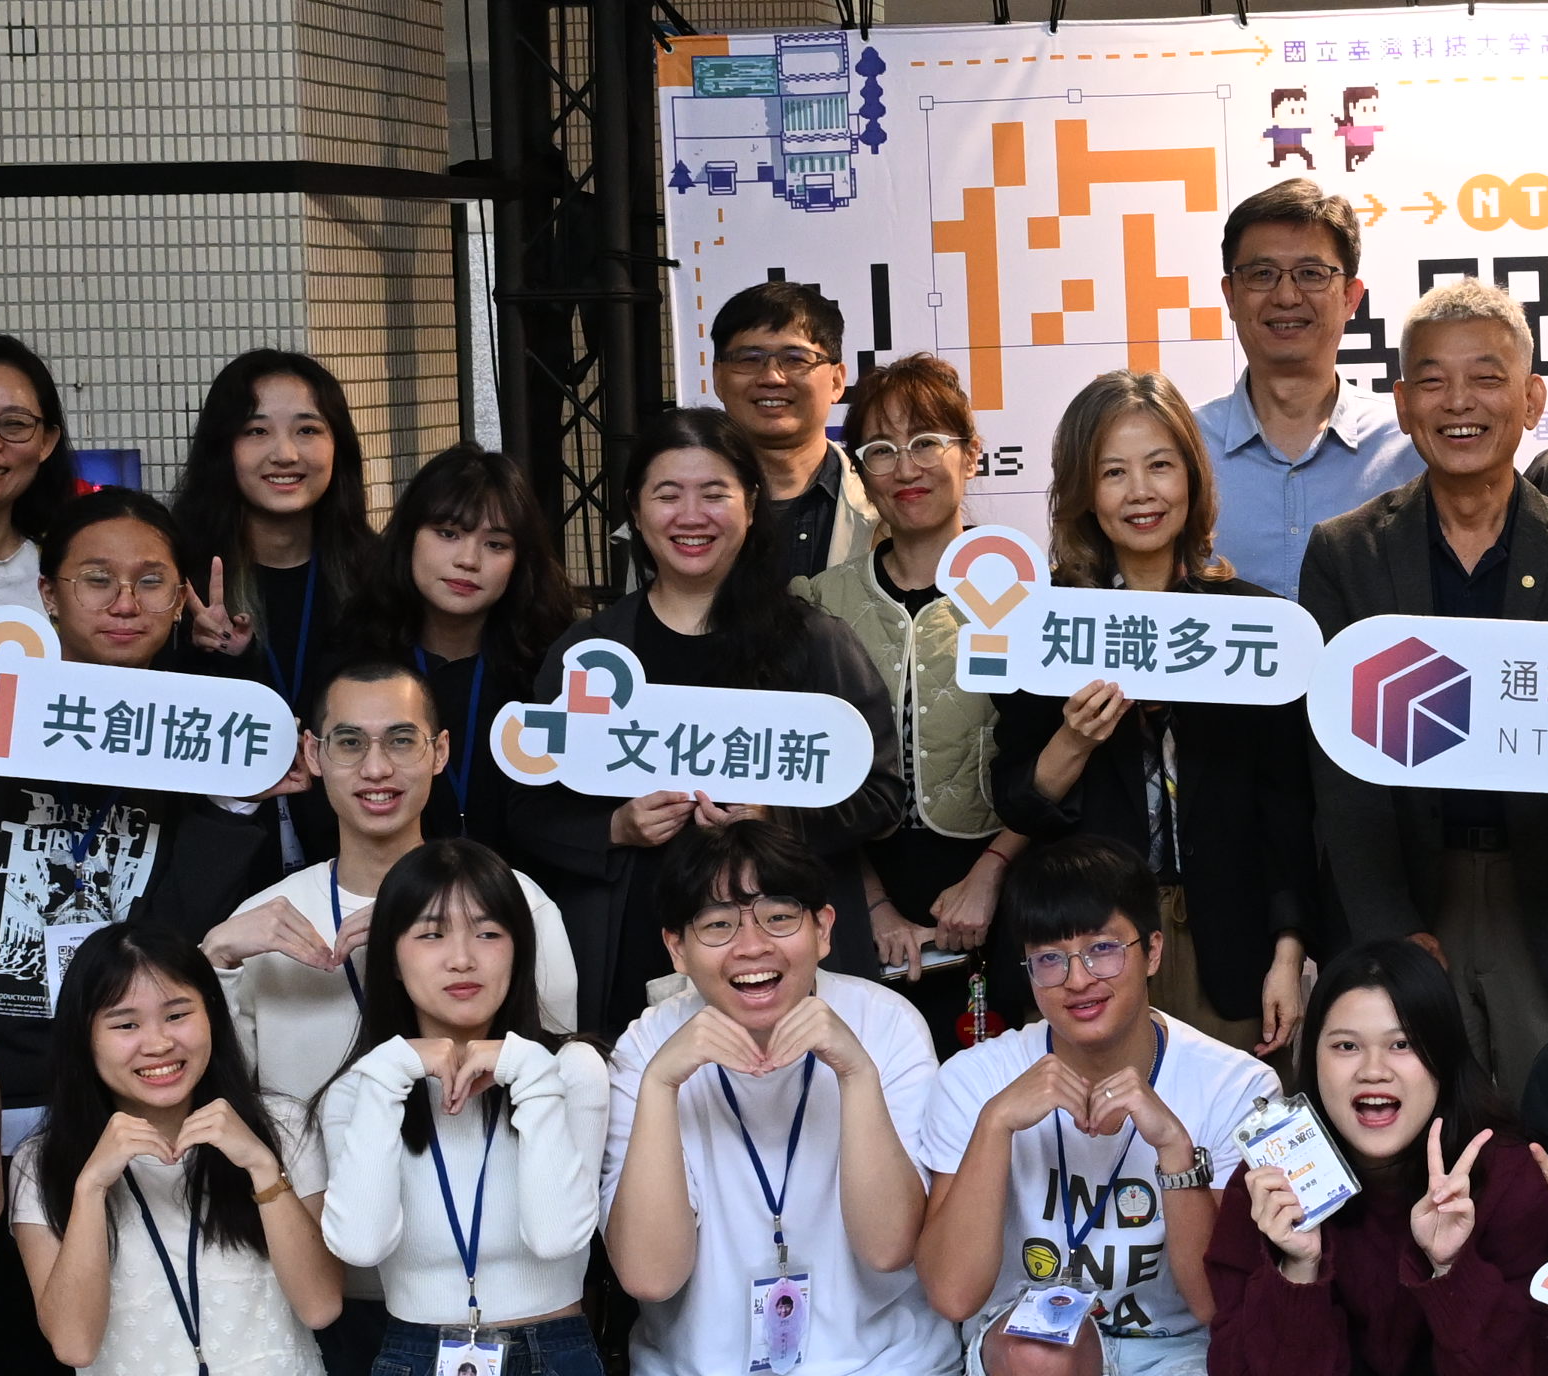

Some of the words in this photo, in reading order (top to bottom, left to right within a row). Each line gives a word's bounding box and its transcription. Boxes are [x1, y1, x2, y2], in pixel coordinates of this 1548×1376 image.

[1040, 610, 1280, 679] 知識多元
[42, 692, 272, 768] 共創協作
[605, 719, 832, 785] 文化創新
[1042, 1168, 1157, 1230] IND
